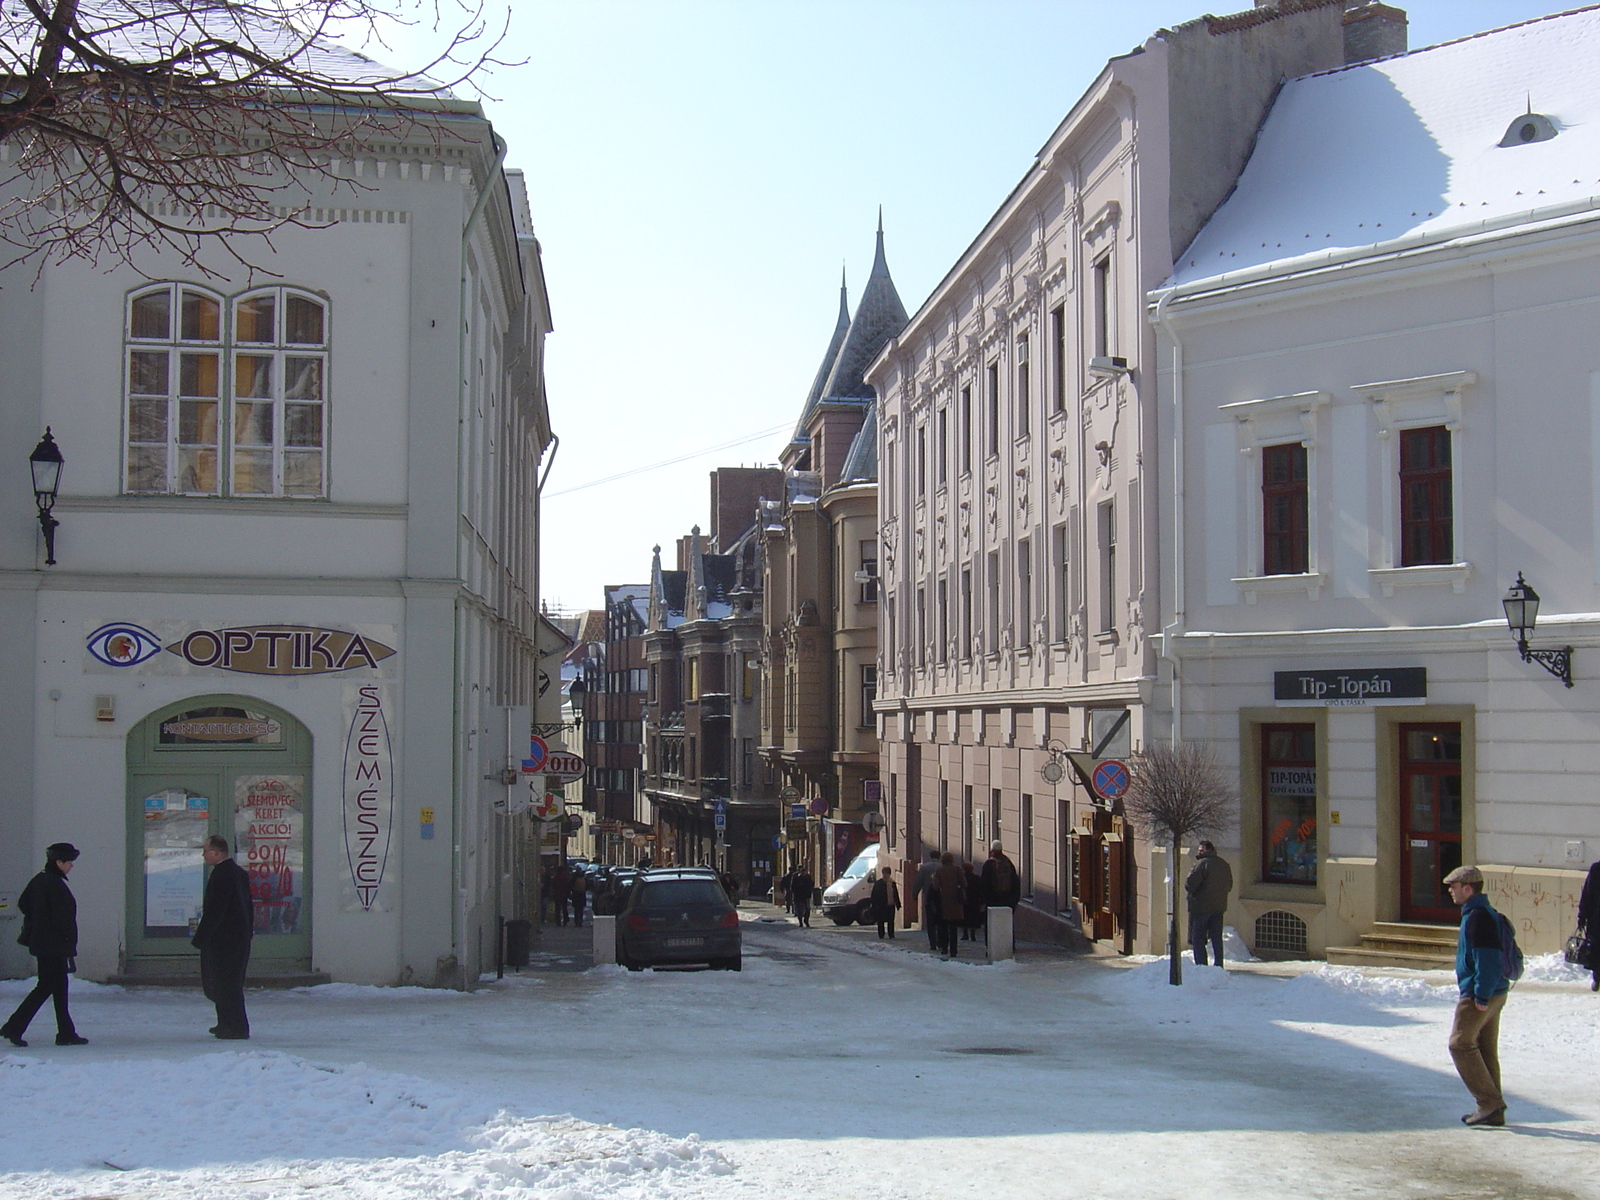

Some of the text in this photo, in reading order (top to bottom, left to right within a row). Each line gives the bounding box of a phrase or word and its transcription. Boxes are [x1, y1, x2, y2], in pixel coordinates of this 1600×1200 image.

[181, 630, 379, 669] OPTIKA
[163, 722, 279, 735] KONTAKTLENCSE
[543, 757, 582, 772] OTO
[354, 686, 382, 908] SZEMÉSZET
[255, 808, 283, 819] KERET
[248, 821, 292, 835] AKCIÓ!
[247, 844, 271, 860] 60
[248, 863, 271, 879] 50
